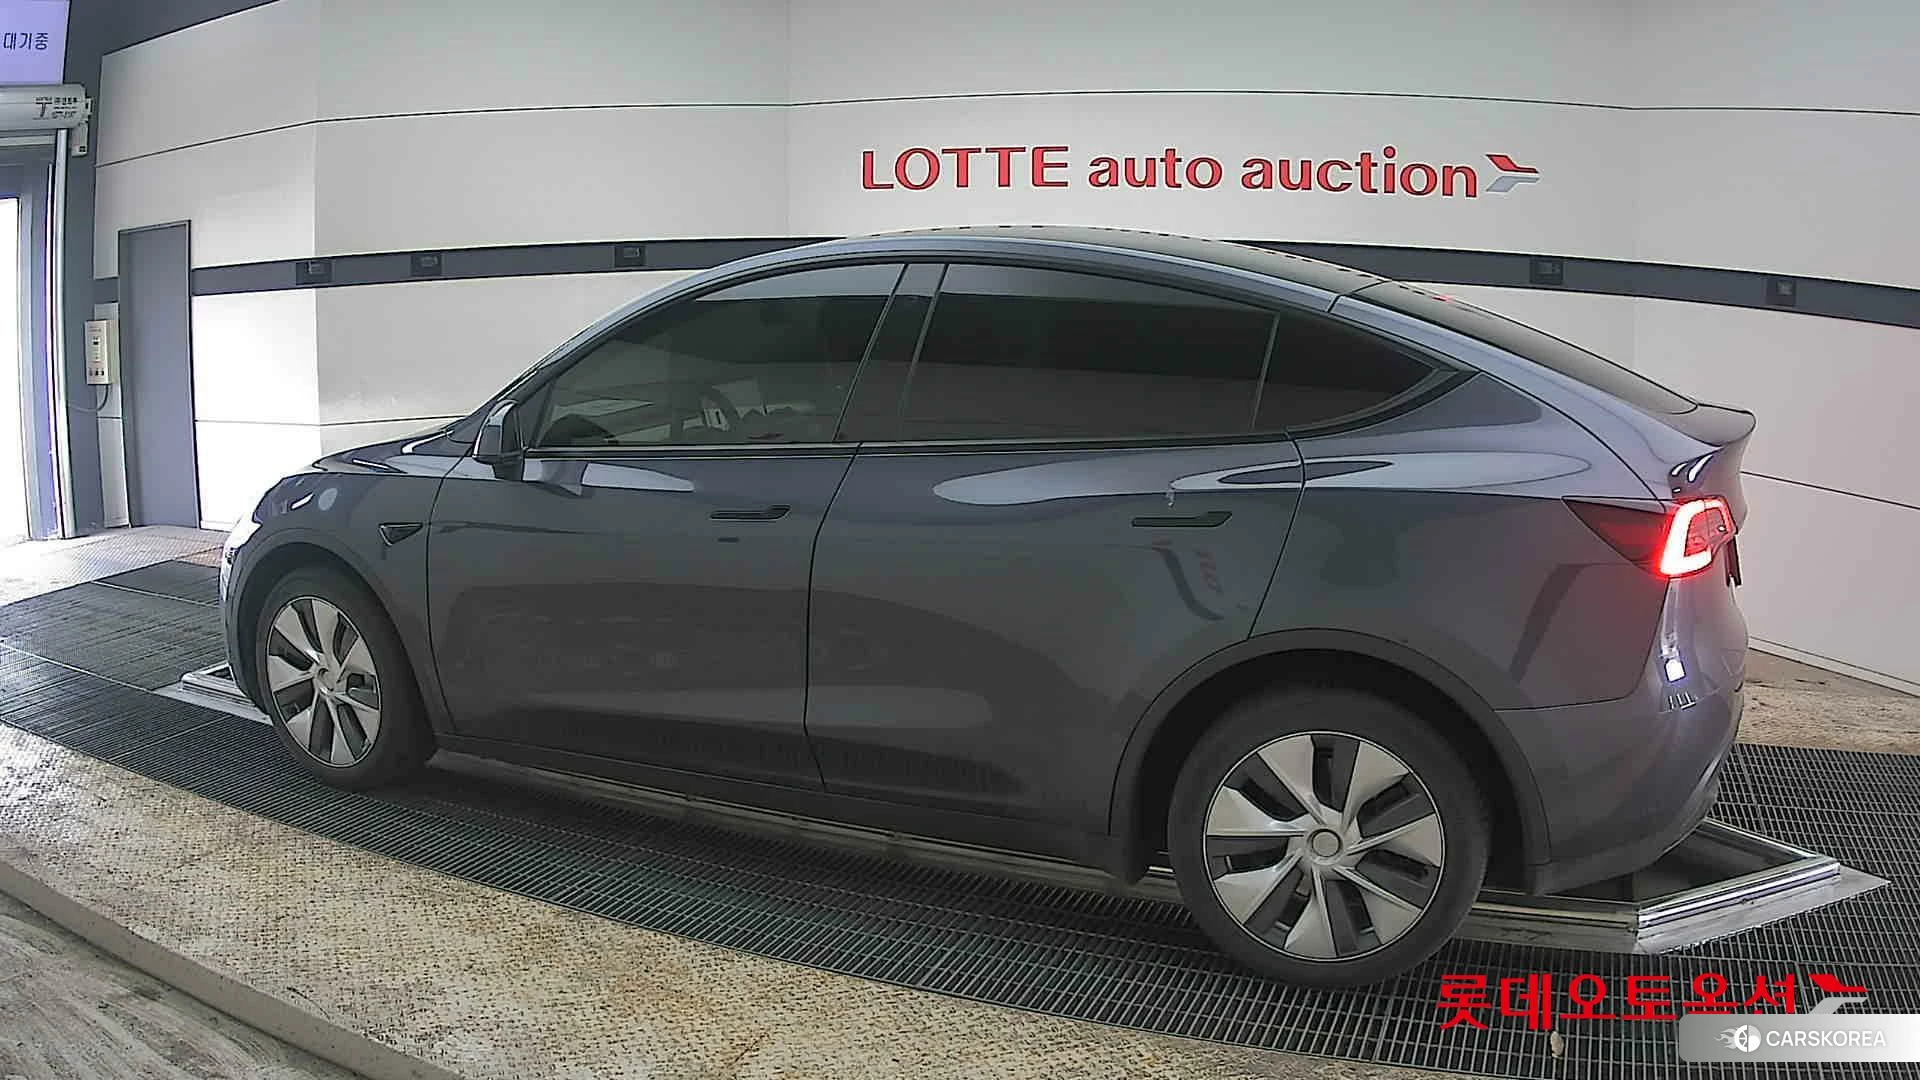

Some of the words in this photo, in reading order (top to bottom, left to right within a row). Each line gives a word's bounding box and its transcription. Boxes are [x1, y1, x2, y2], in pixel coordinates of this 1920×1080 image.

[3, 31, 49, 51] 대기중
[861, 145, 1069, 191] LOTTE
[1087, 147, 1224, 190] auto
[1240, 145, 1480, 198] auction
